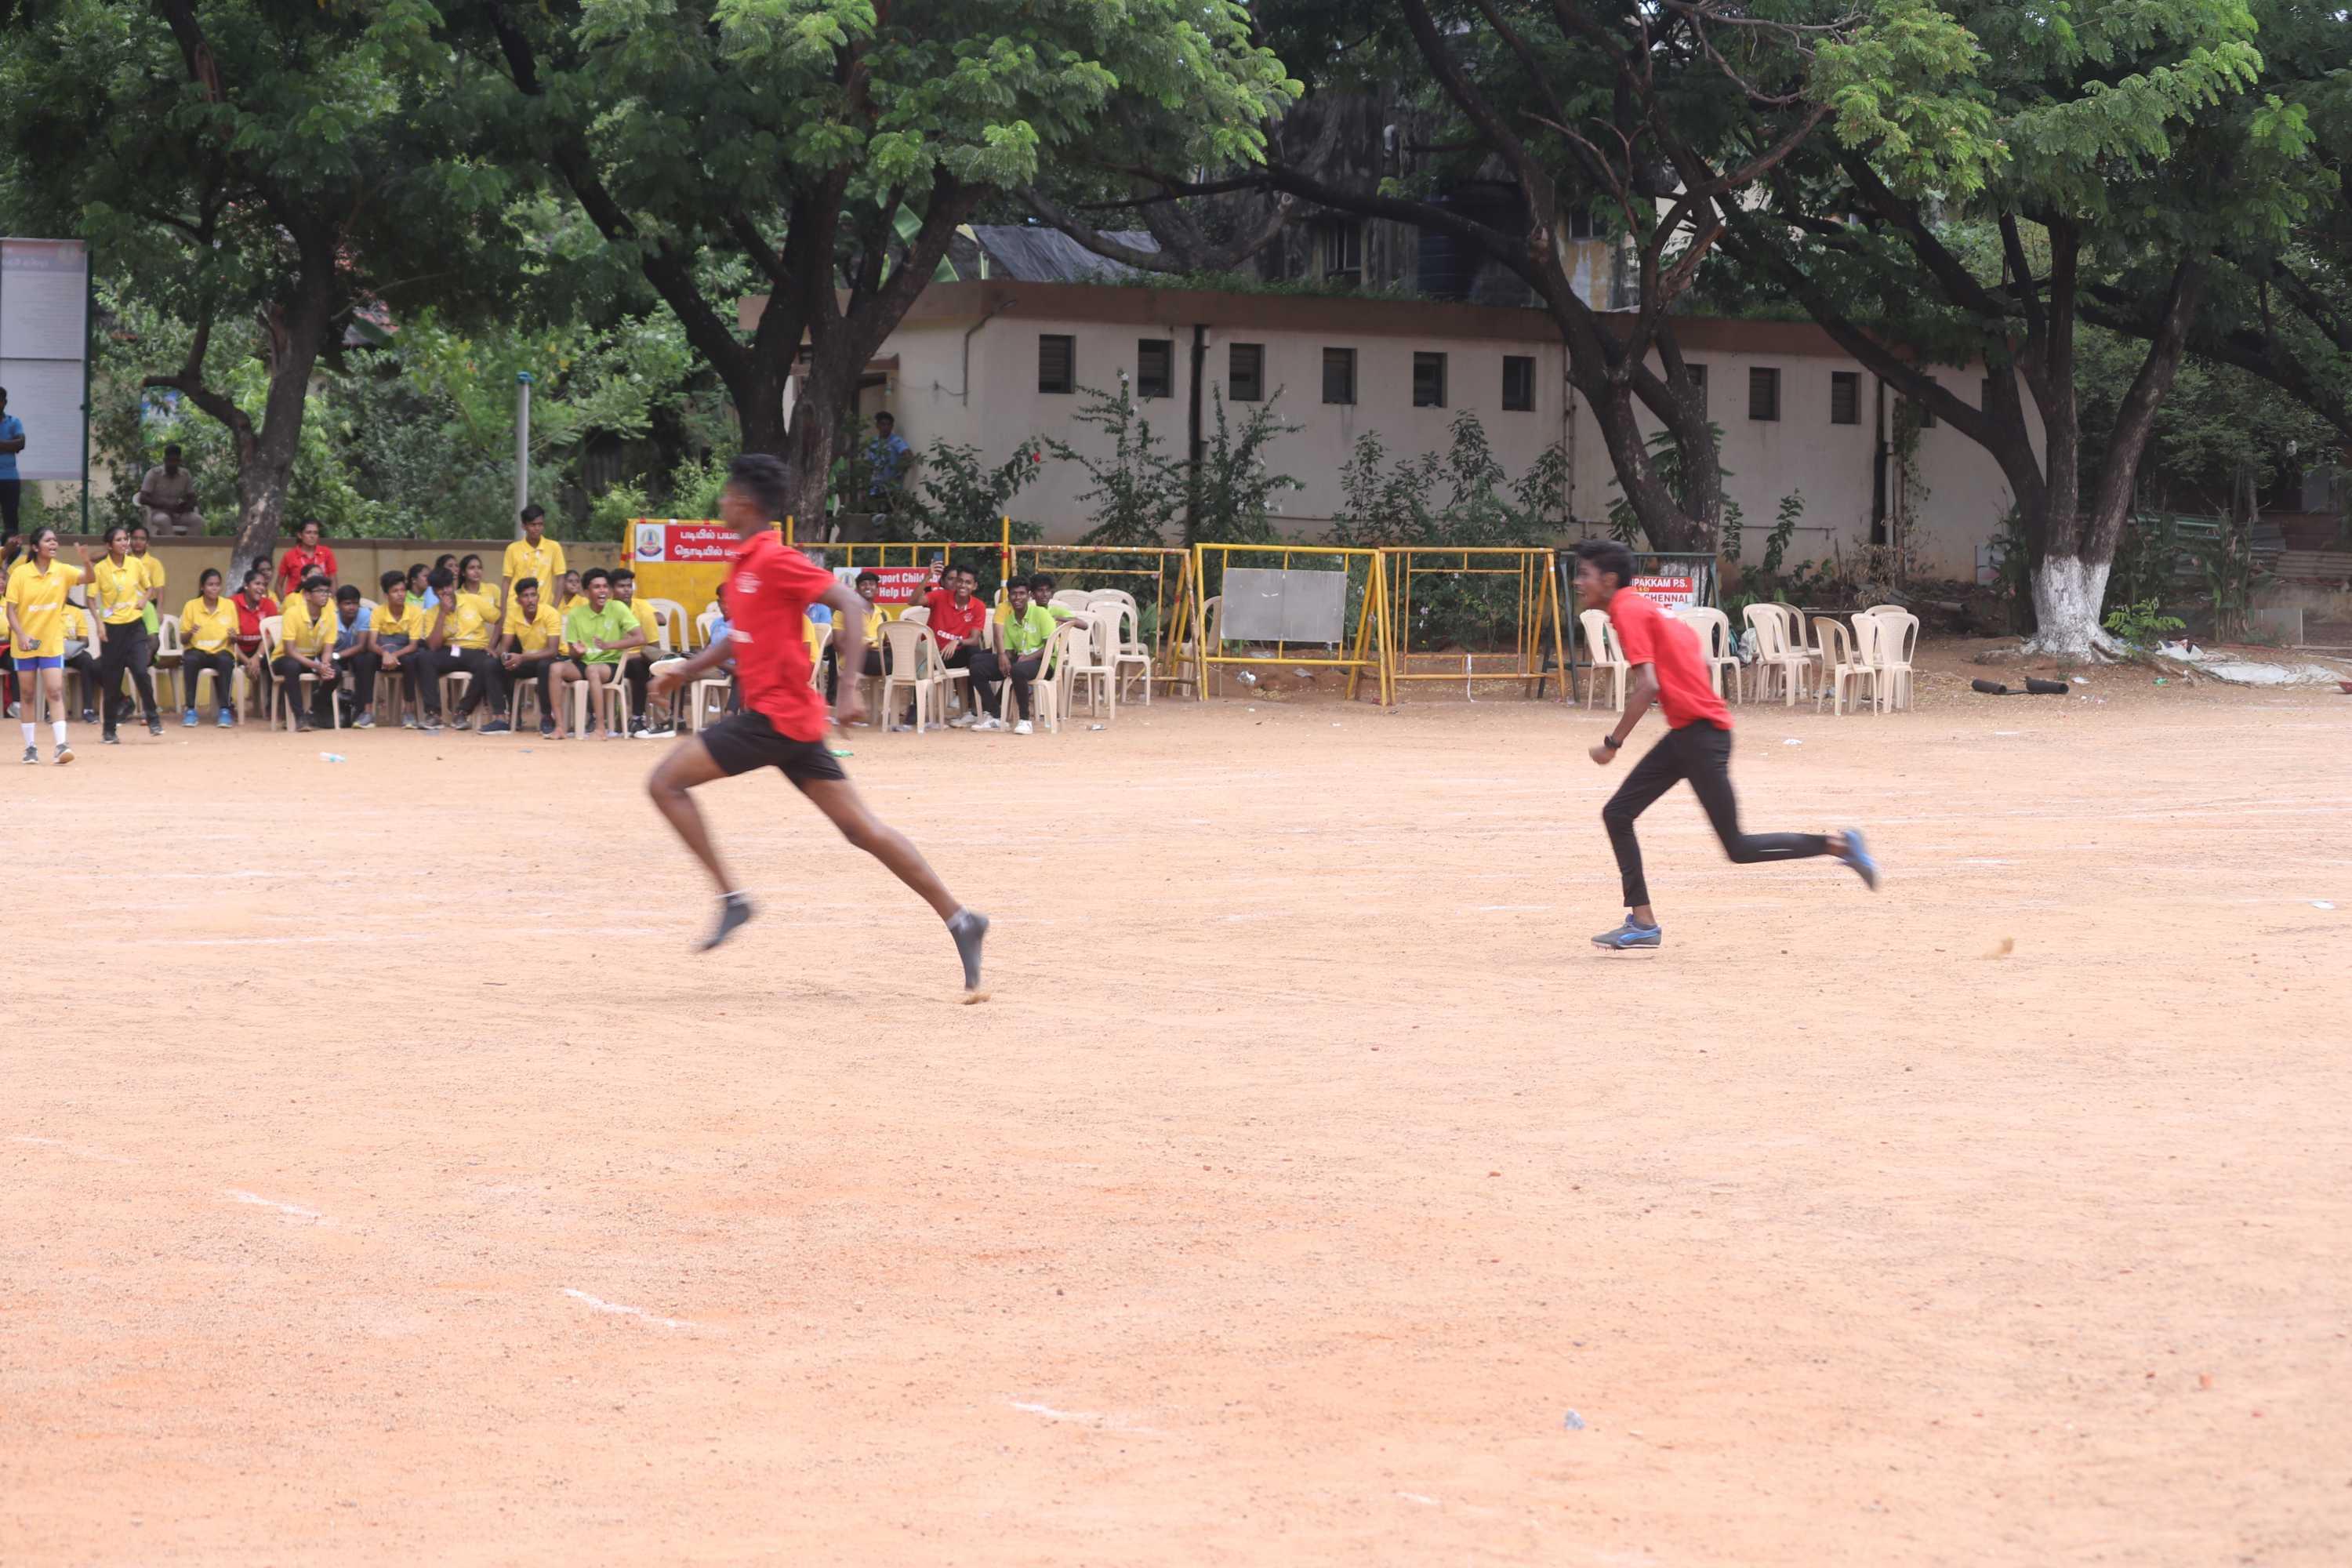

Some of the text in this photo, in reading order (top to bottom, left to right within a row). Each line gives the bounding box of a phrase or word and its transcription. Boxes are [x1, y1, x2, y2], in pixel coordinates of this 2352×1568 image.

[1631, 578, 1688, 588] IPAKKAM P.S.
[879, 586, 899, 599] Help
